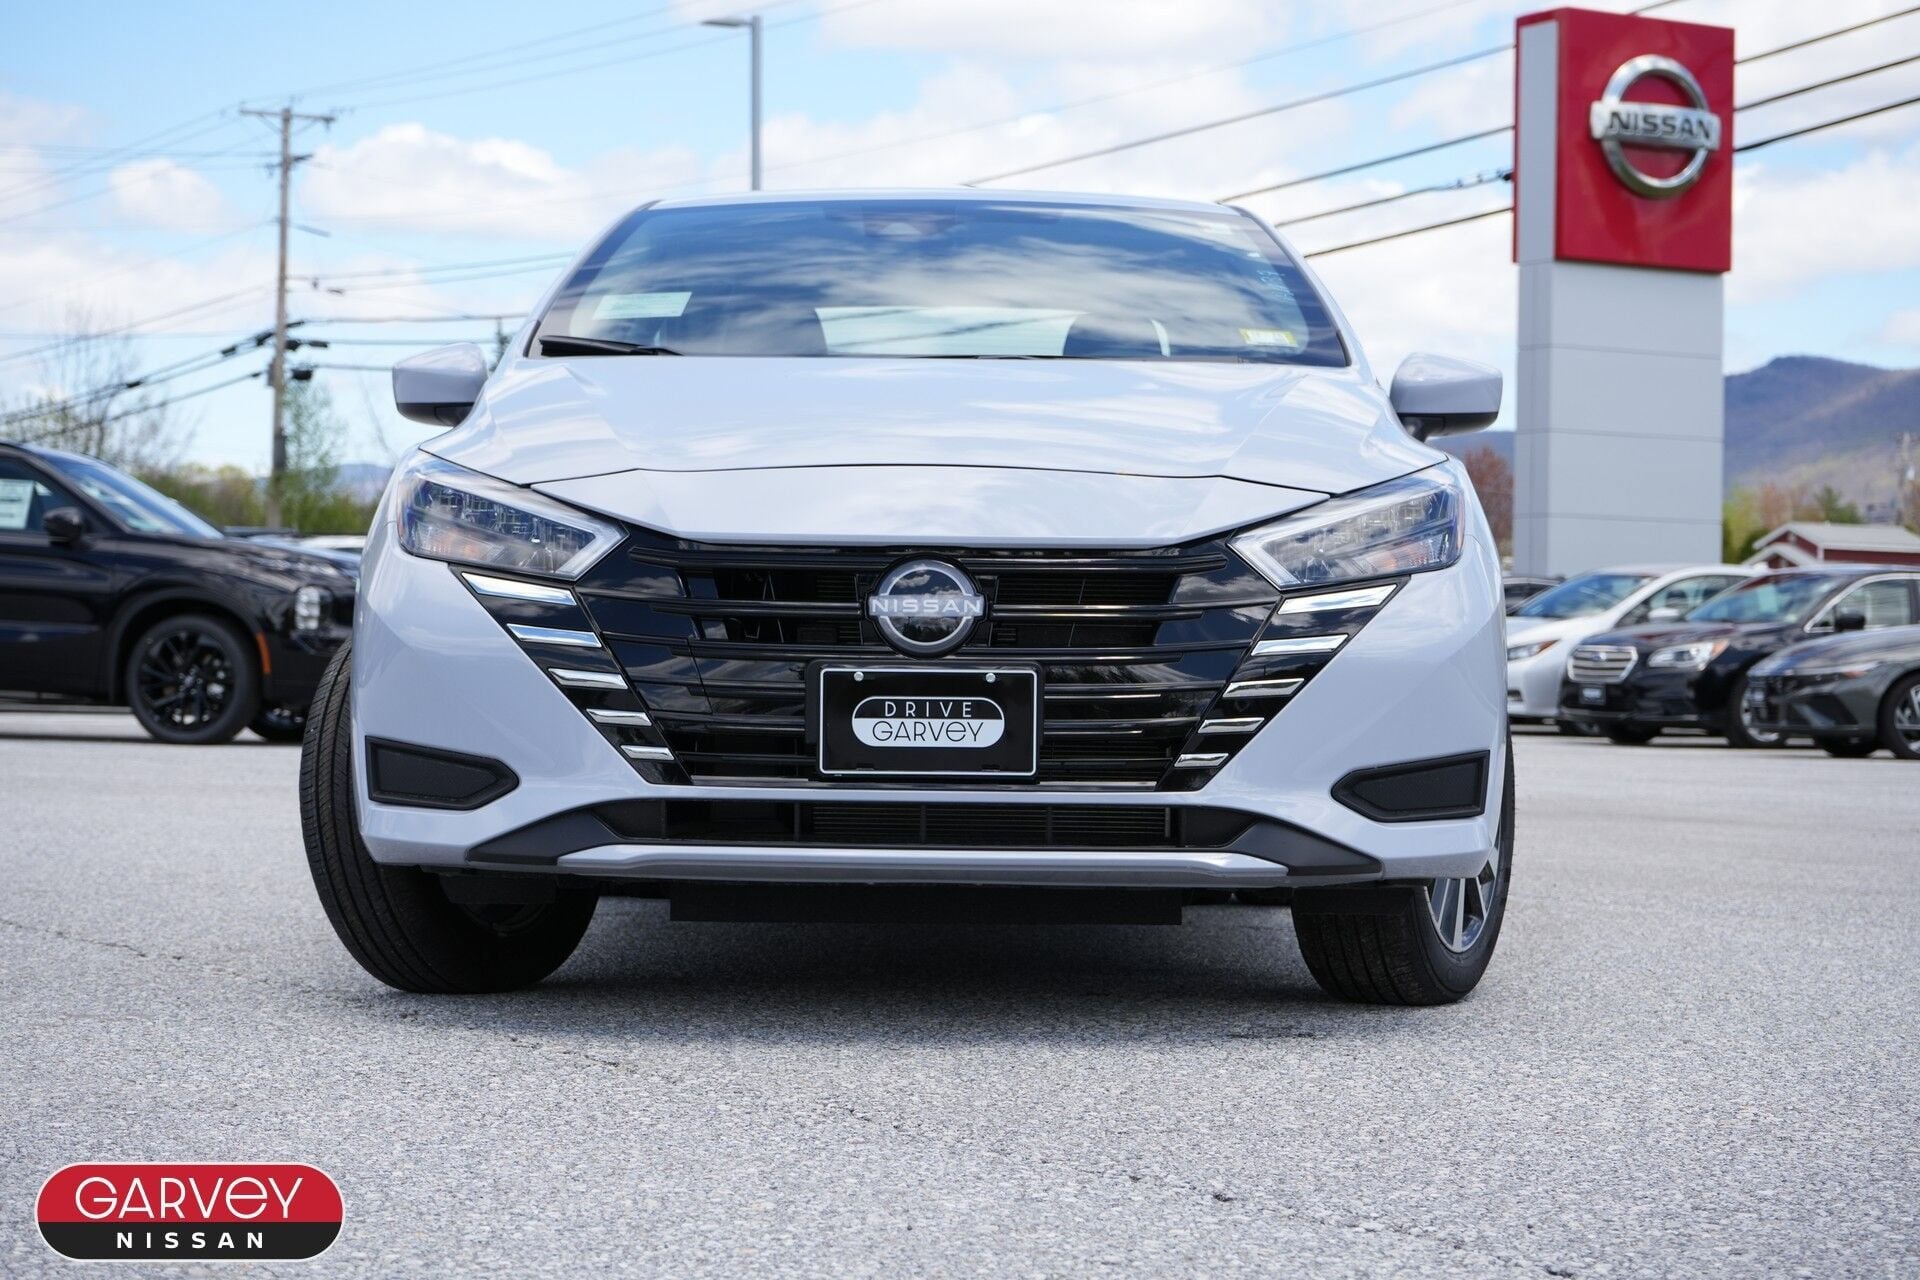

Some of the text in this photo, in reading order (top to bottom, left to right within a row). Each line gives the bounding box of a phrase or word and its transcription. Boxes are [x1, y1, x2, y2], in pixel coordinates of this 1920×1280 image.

[1608, 110, 1712, 142] NISSAN
[872, 598, 981, 613] NISSAN
[884, 701, 972, 717] DRIVE
